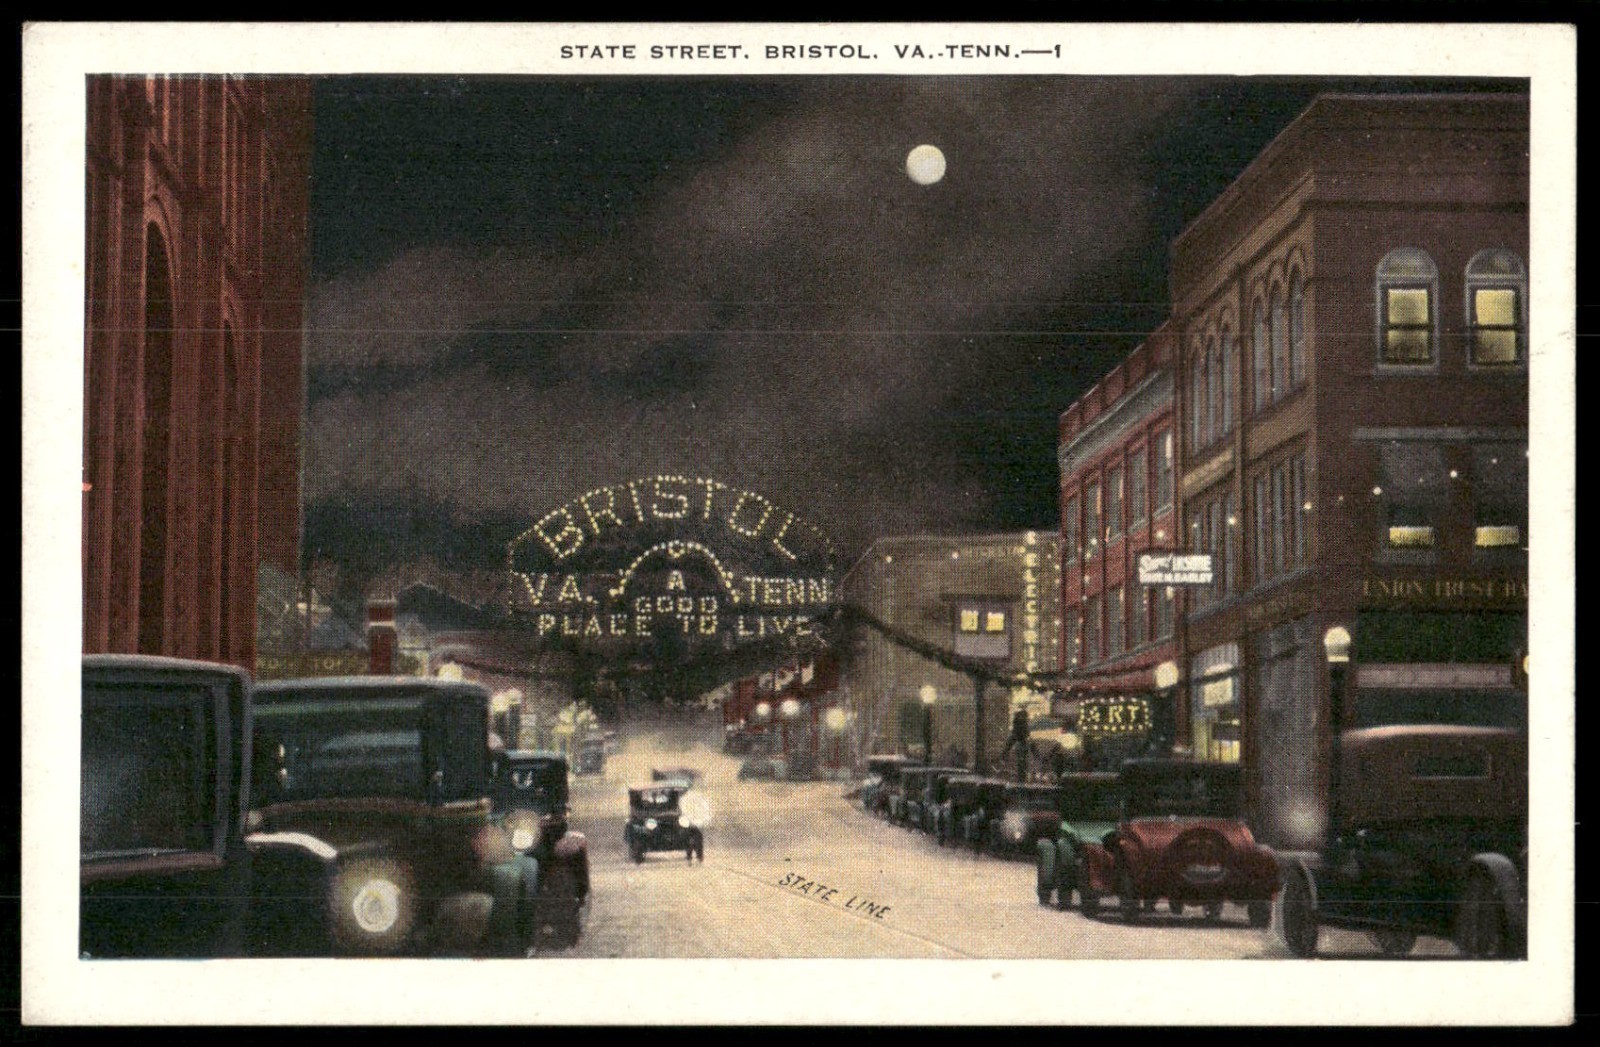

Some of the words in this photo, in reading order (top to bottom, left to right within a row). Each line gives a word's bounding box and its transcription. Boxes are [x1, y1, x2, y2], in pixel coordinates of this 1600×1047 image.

[533, 474, 797, 560] BRISTOL
[519, 572, 597, 606] VA.
[668, 570, 686, 591] A
[743, 576, 829, 604] TENN
[635, 596, 719, 614] GOOD
[539, 613, 652, 636] PLACE
[675, 613, 719, 636] TO
[738, 614, 813, 636] LIVE
[778, 872, 839, 901] STATE
[844, 895, 891, 919] LINE
